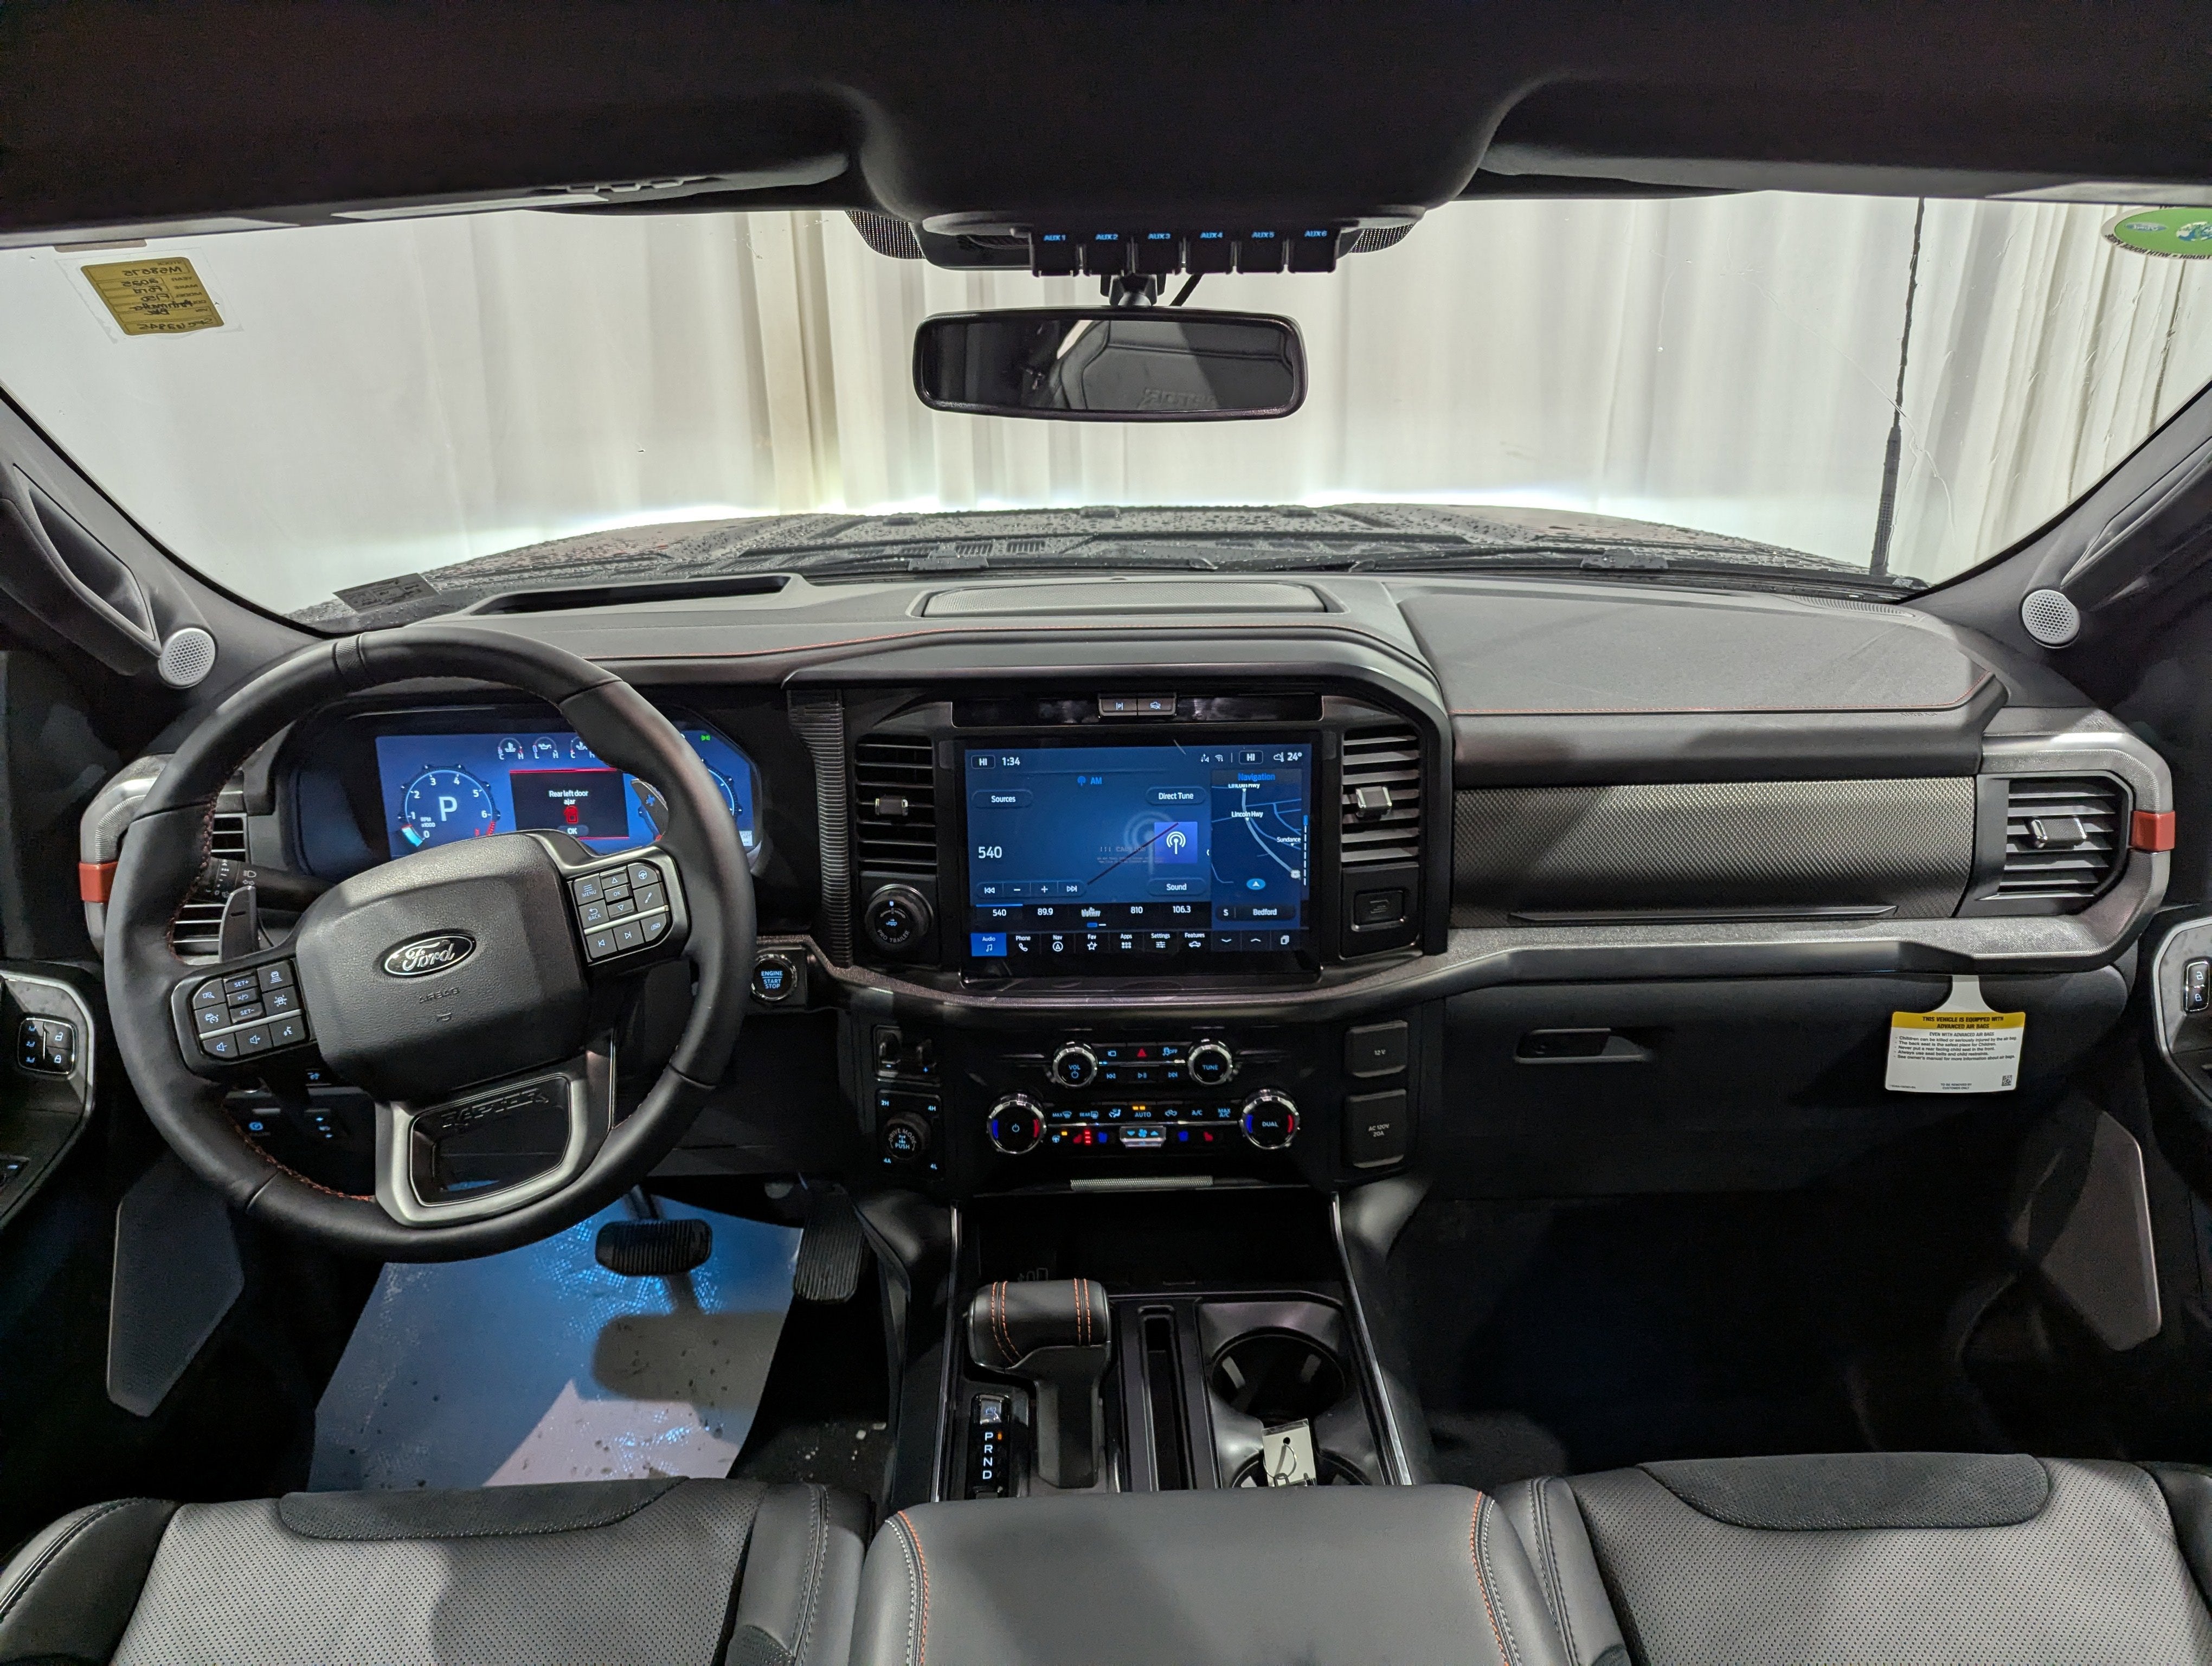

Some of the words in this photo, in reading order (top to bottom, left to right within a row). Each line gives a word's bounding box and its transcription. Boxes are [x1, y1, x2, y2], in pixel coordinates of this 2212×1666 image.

[1002, 757, 1020, 766] 1:34
[1238, 773, 1276, 781] Navigation
[414, 791, 421, 799] 2
[439, 796, 458, 822] P
[423, 830, 430, 838] 0
[978, 847, 1002, 858] 540
[582, 890, 597, 898] MENU
[1173, 905, 1191, 913] 106.3
[1223, 908, 1229, 917] S
[877, 929, 888, 940] PRO
[889, 930, 910, 943] TRAILER
[402, 942, 455, 971] Ford
[888, 1128, 901, 1143] DRIVE
[902, 1129, 916, 1144] MODE
[985, 1432, 994, 1441] P
[984, 1445, 993, 1453] R
[983, 1457, 993, 1466] N
[982, 1470, 992, 1479] D
